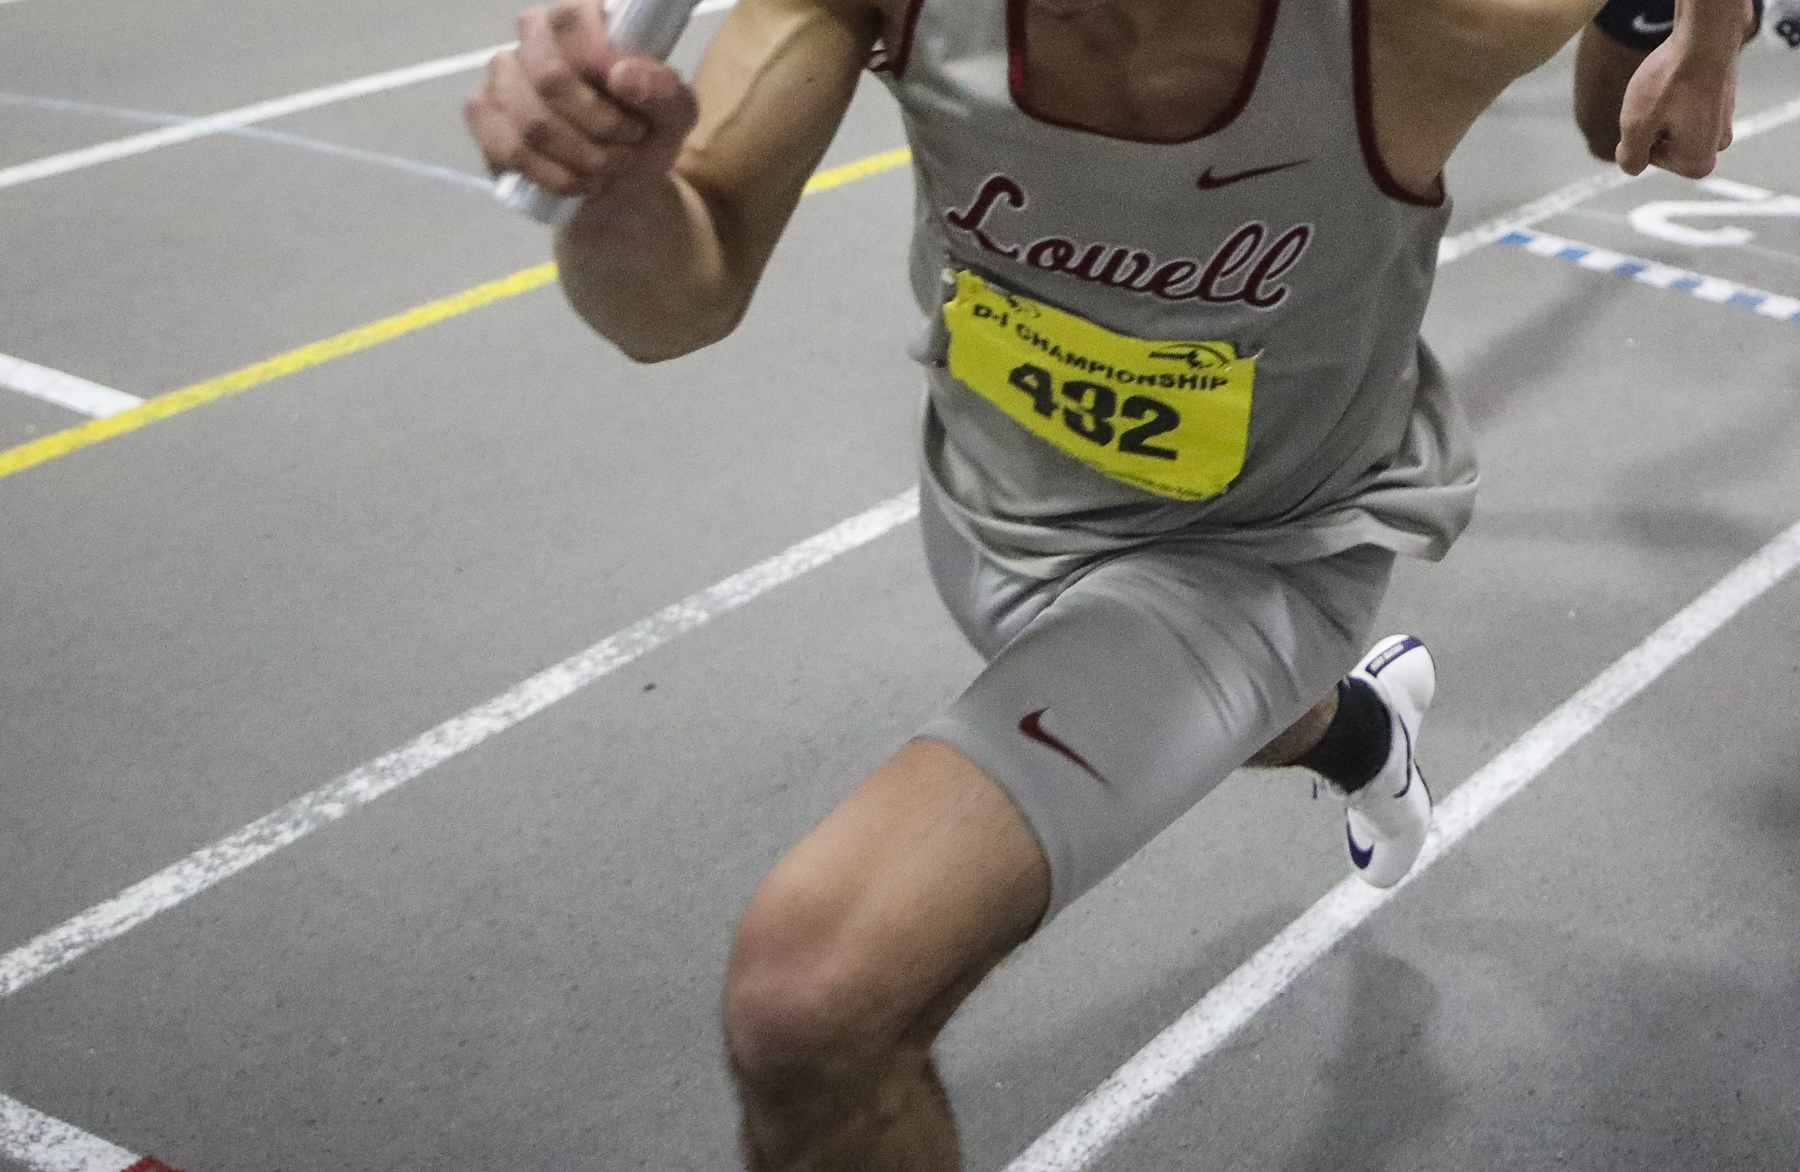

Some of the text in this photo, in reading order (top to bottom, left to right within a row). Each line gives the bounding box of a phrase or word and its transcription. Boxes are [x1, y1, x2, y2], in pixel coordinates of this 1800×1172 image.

[945, 173, 1316, 311] Lowell
[1015, 323, 1229, 391] CHAMPIONSHIP
[1007, 362, 1182, 462] 432
